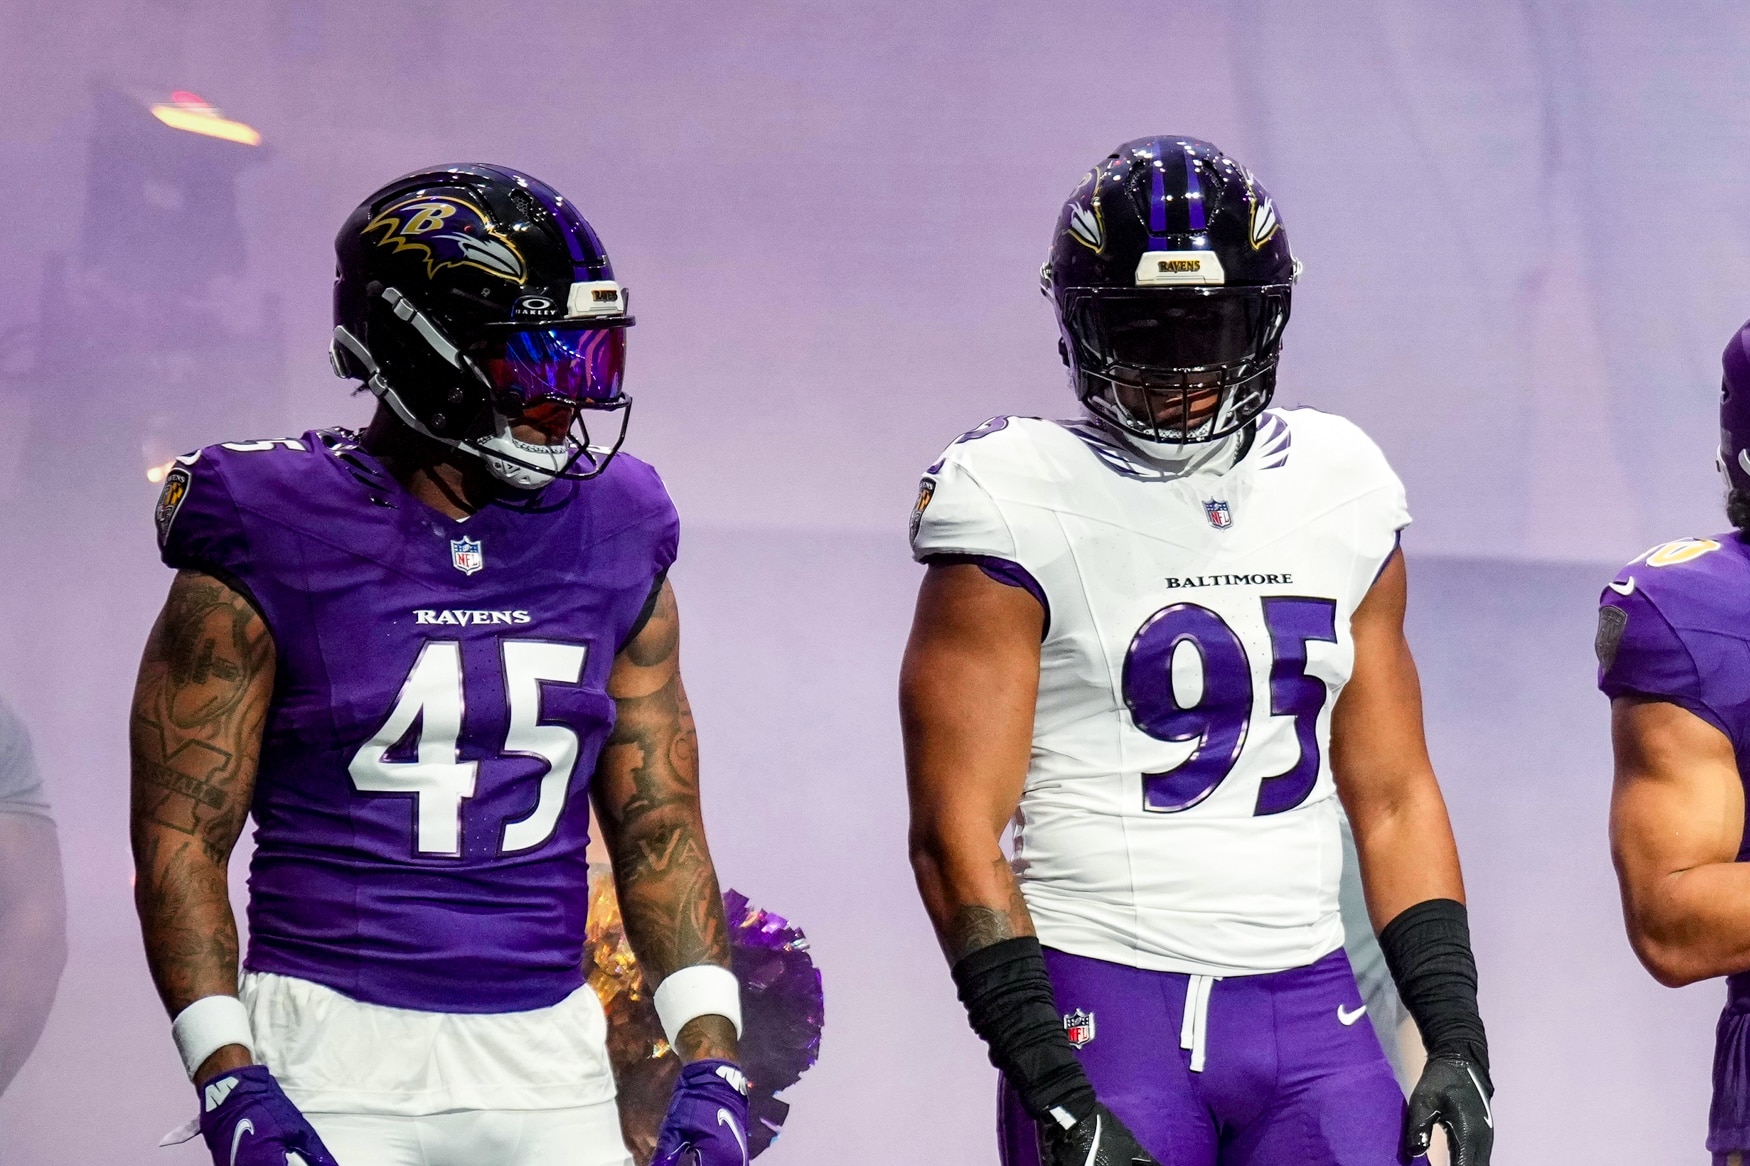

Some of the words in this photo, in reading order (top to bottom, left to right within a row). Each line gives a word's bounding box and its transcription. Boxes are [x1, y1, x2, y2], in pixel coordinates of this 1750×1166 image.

[400, 202, 457, 235] B
[1158, 260, 1200, 274] RAVENS
[1210, 510, 1231, 526] NFL
[456, 553, 478, 568] NFL
[1165, 573, 1293, 589] BALTIMORE
[413, 609, 532, 627] RAVENS
[1121, 595, 1338, 817] 95
[347, 639, 588, 857] 45
